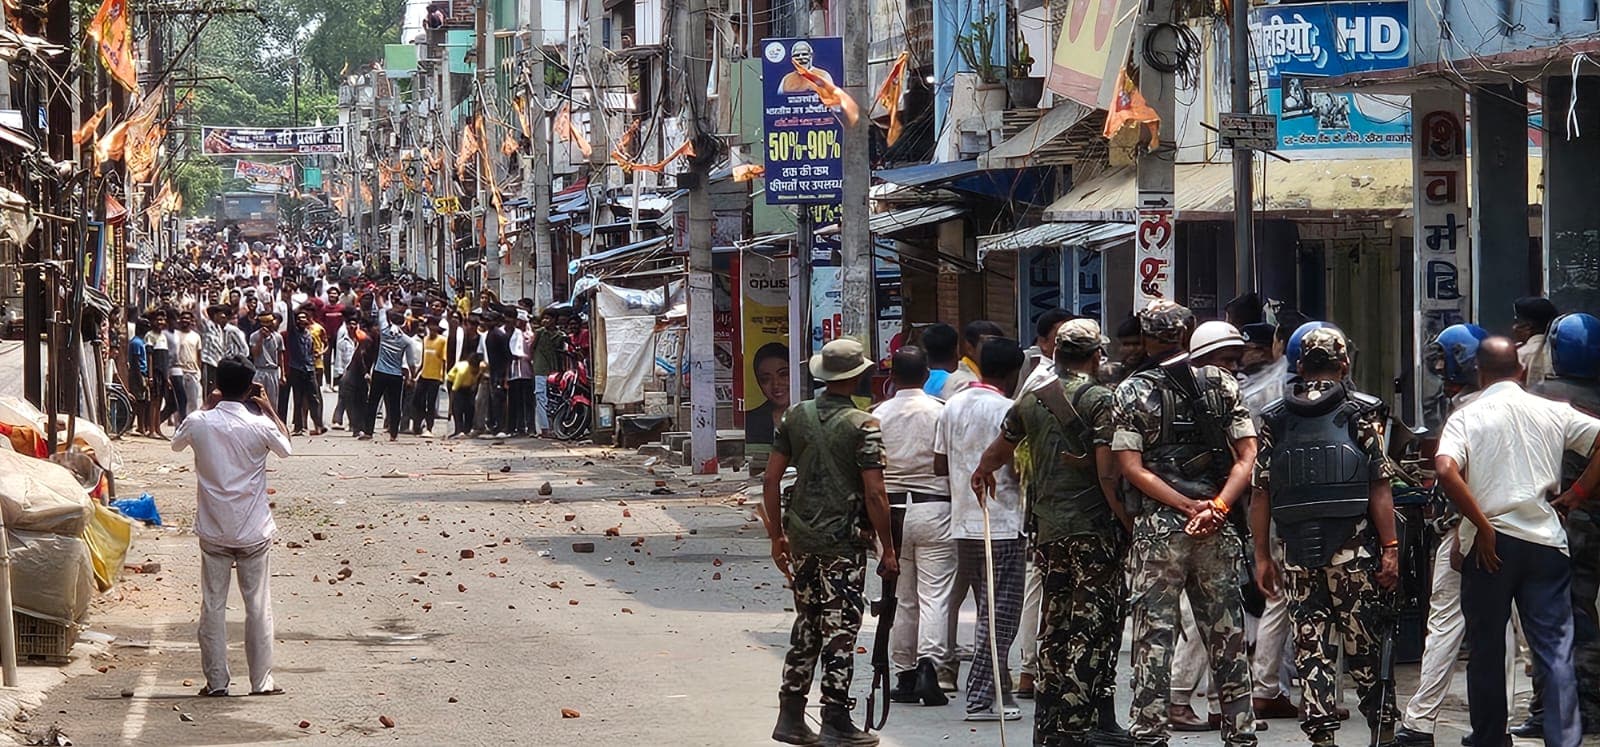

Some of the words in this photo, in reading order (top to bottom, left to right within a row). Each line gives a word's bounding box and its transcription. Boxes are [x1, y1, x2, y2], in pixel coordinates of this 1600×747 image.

[1336, 16, 1401, 53] HD
[276, 129, 293, 145] हरि
[769, 130, 841, 161] 50%-90%
[782, 167, 797, 177] तक
[799, 165, 811, 176] की
[813, 166, 829, 176] कम
